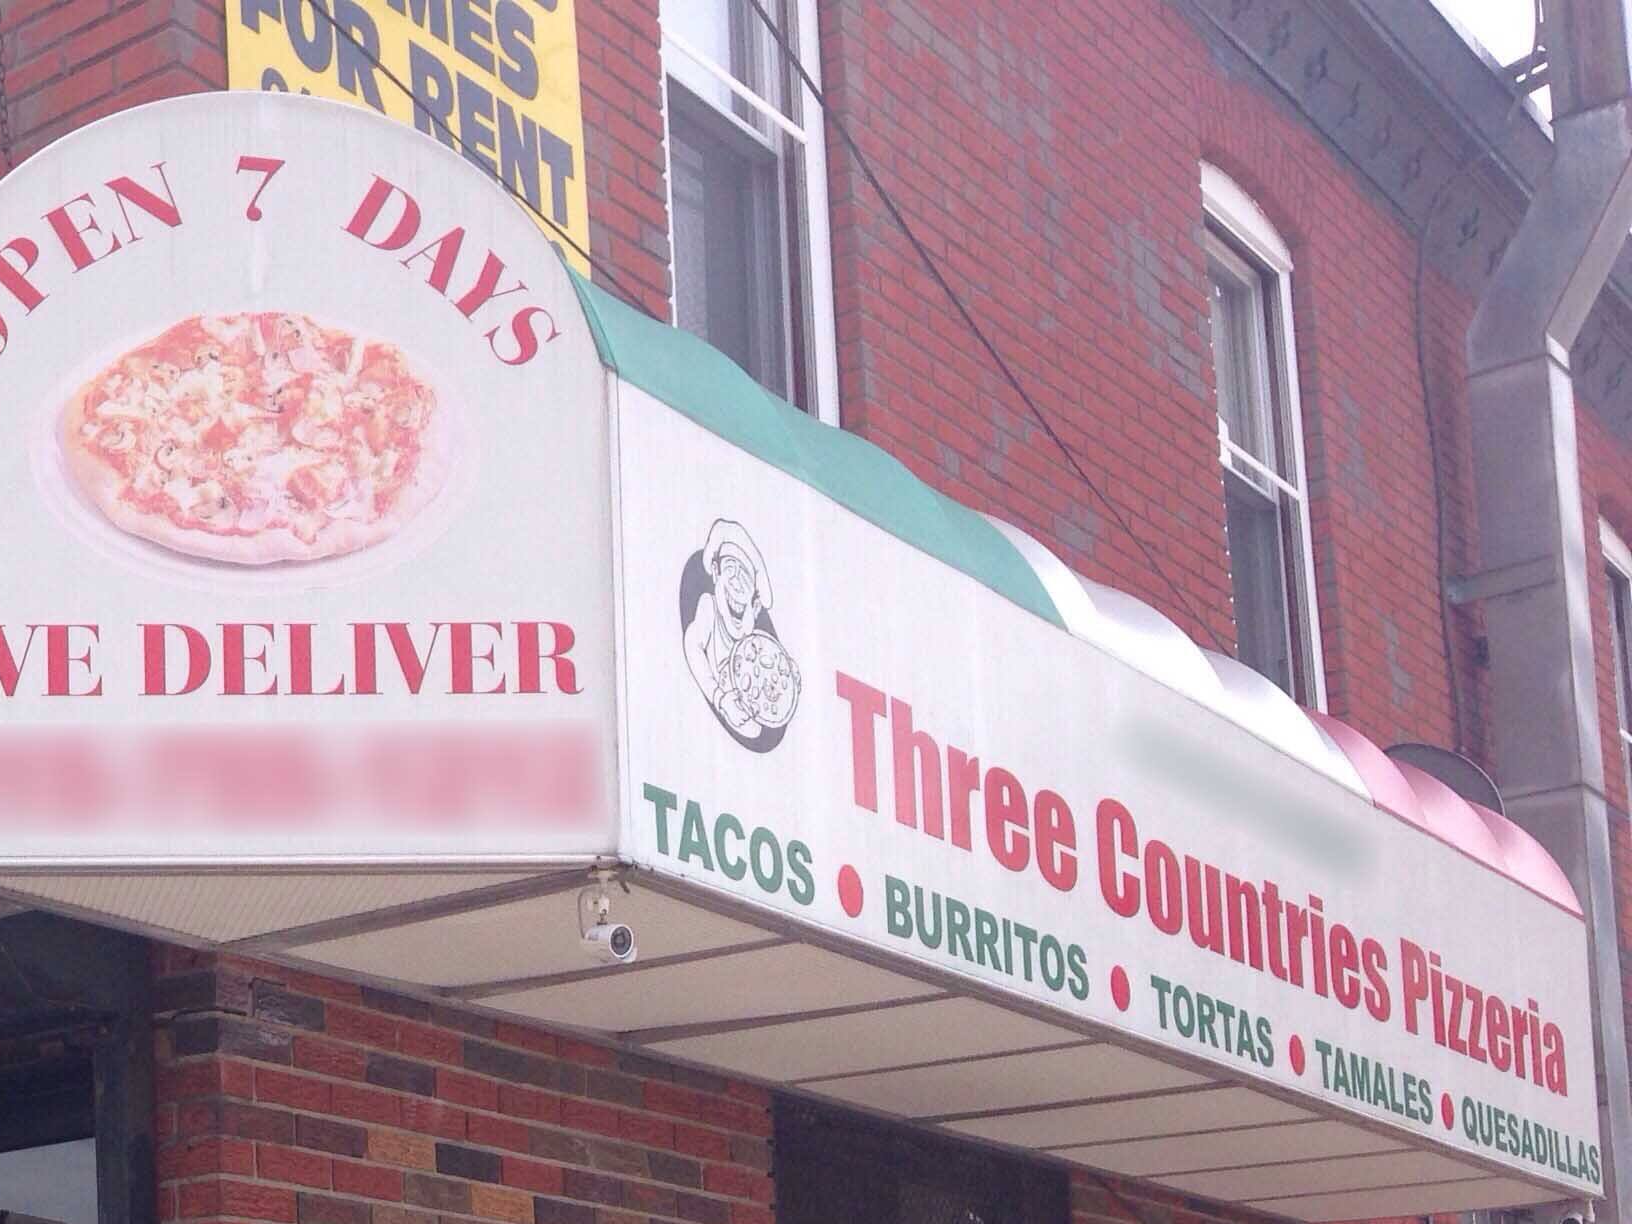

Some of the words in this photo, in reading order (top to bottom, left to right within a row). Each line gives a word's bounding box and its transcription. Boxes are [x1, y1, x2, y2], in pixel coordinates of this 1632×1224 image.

[409, 40, 574, 229] RENT
[236, 155, 286, 222] 7
[340, 173, 562, 367] DAYS
[137, 621, 585, 697] DELIVER
[643, 782, 816, 906] TACOS
[885, 874, 1090, 1001] BURRITOS
[1151, 975, 1275, 1068] TORTAS
[1315, 1039, 1435, 1125] TAMALES
[1462, 1096, 1601, 1185] QUESADILLAS
[836, 670, 1078, 893] Three
[1096, 797, 1391, 1023] Countries
[1400, 937, 1568, 1098] Pizzeria
